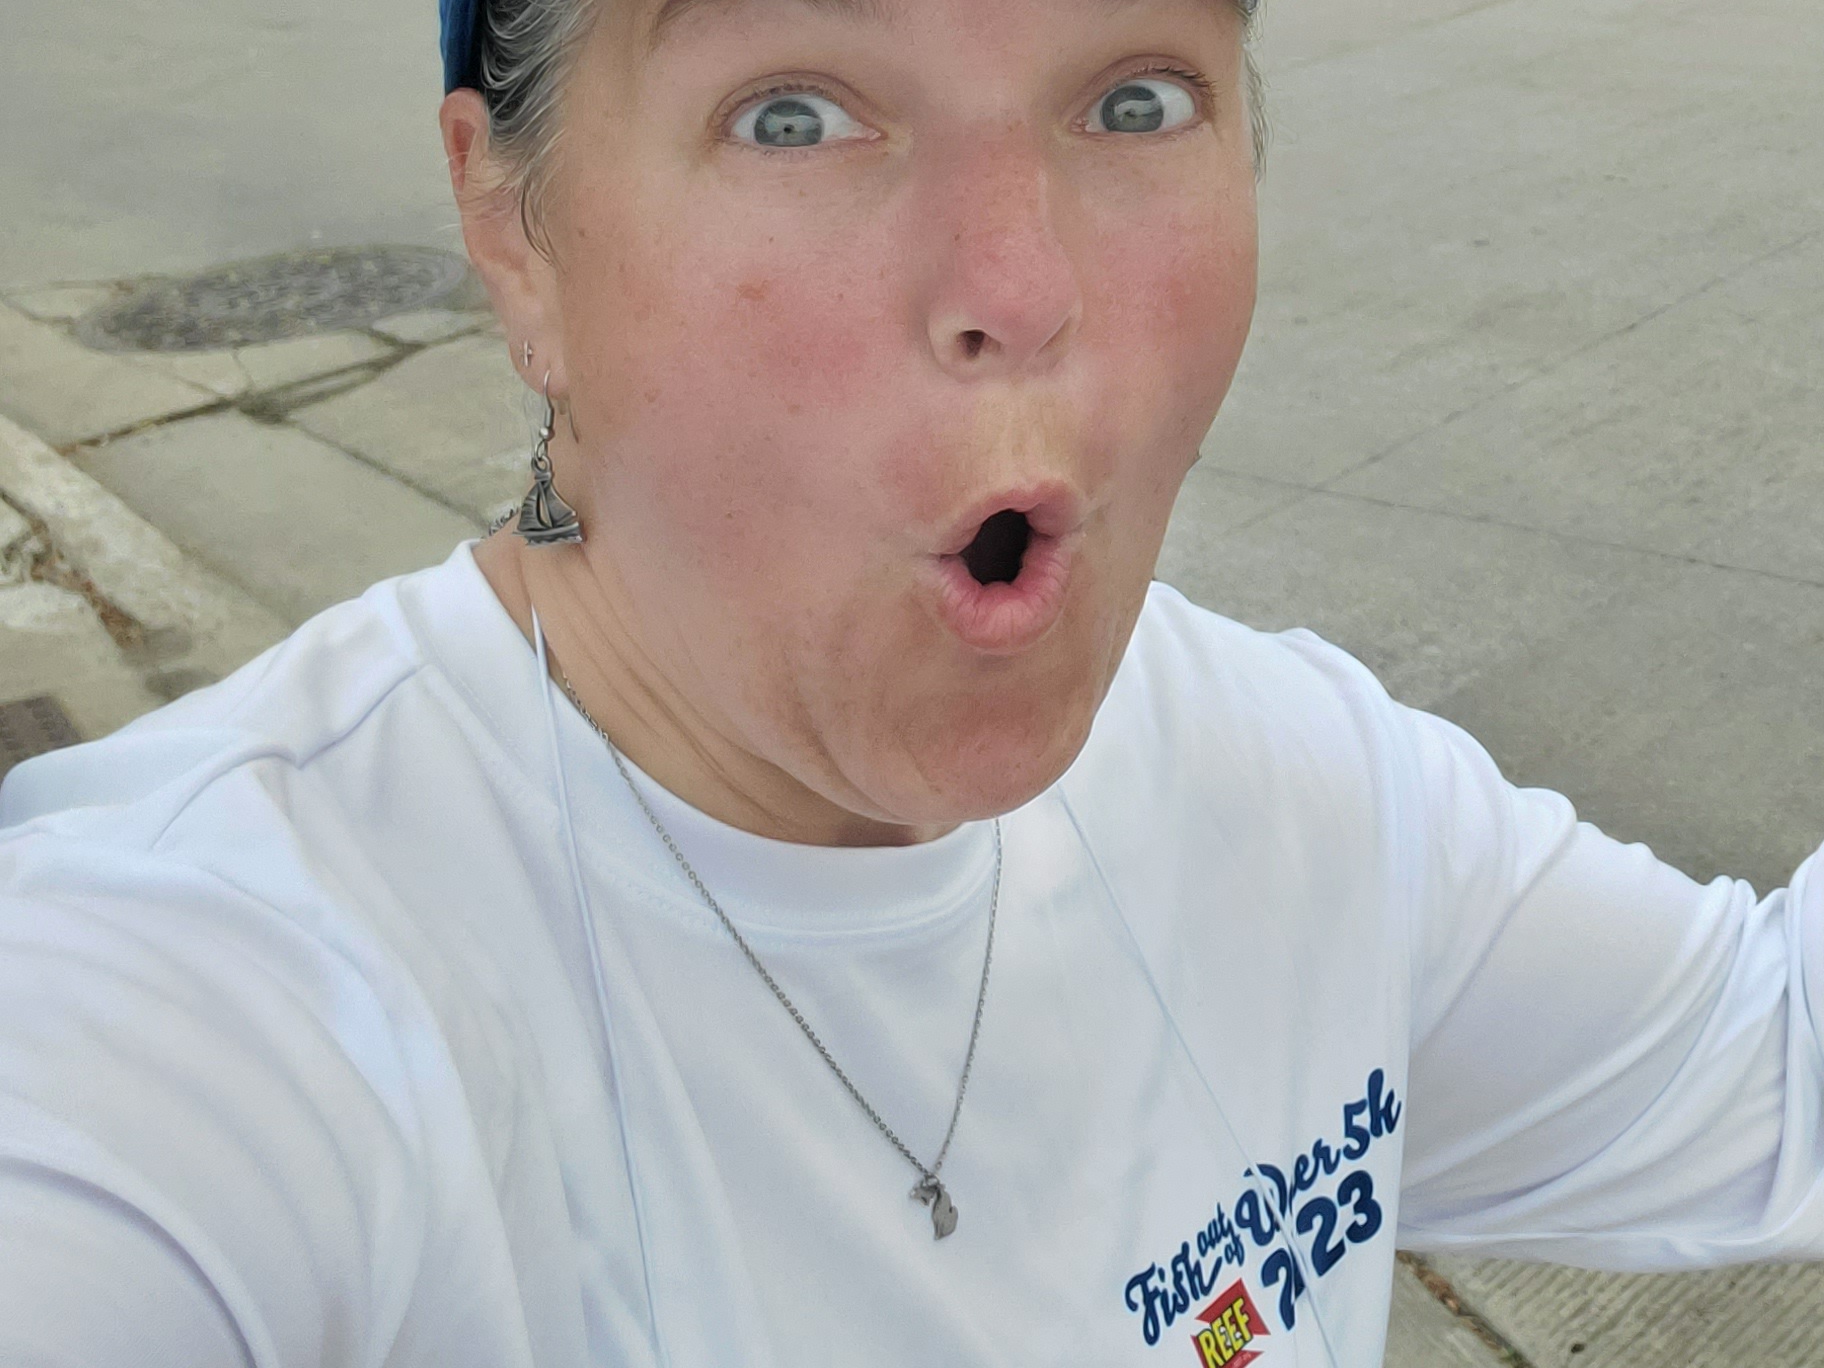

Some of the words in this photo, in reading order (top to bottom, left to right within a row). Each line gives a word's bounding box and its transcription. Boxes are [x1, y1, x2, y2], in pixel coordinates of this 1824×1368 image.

[1125, 1240, 1223, 1346] Fish
[1197, 1201, 1230, 1258] out
[1234, 1137, 1341, 1247] Wer
[1260, 1169, 1382, 1331] 223
[1196, 1295, 1254, 1368] REEF
